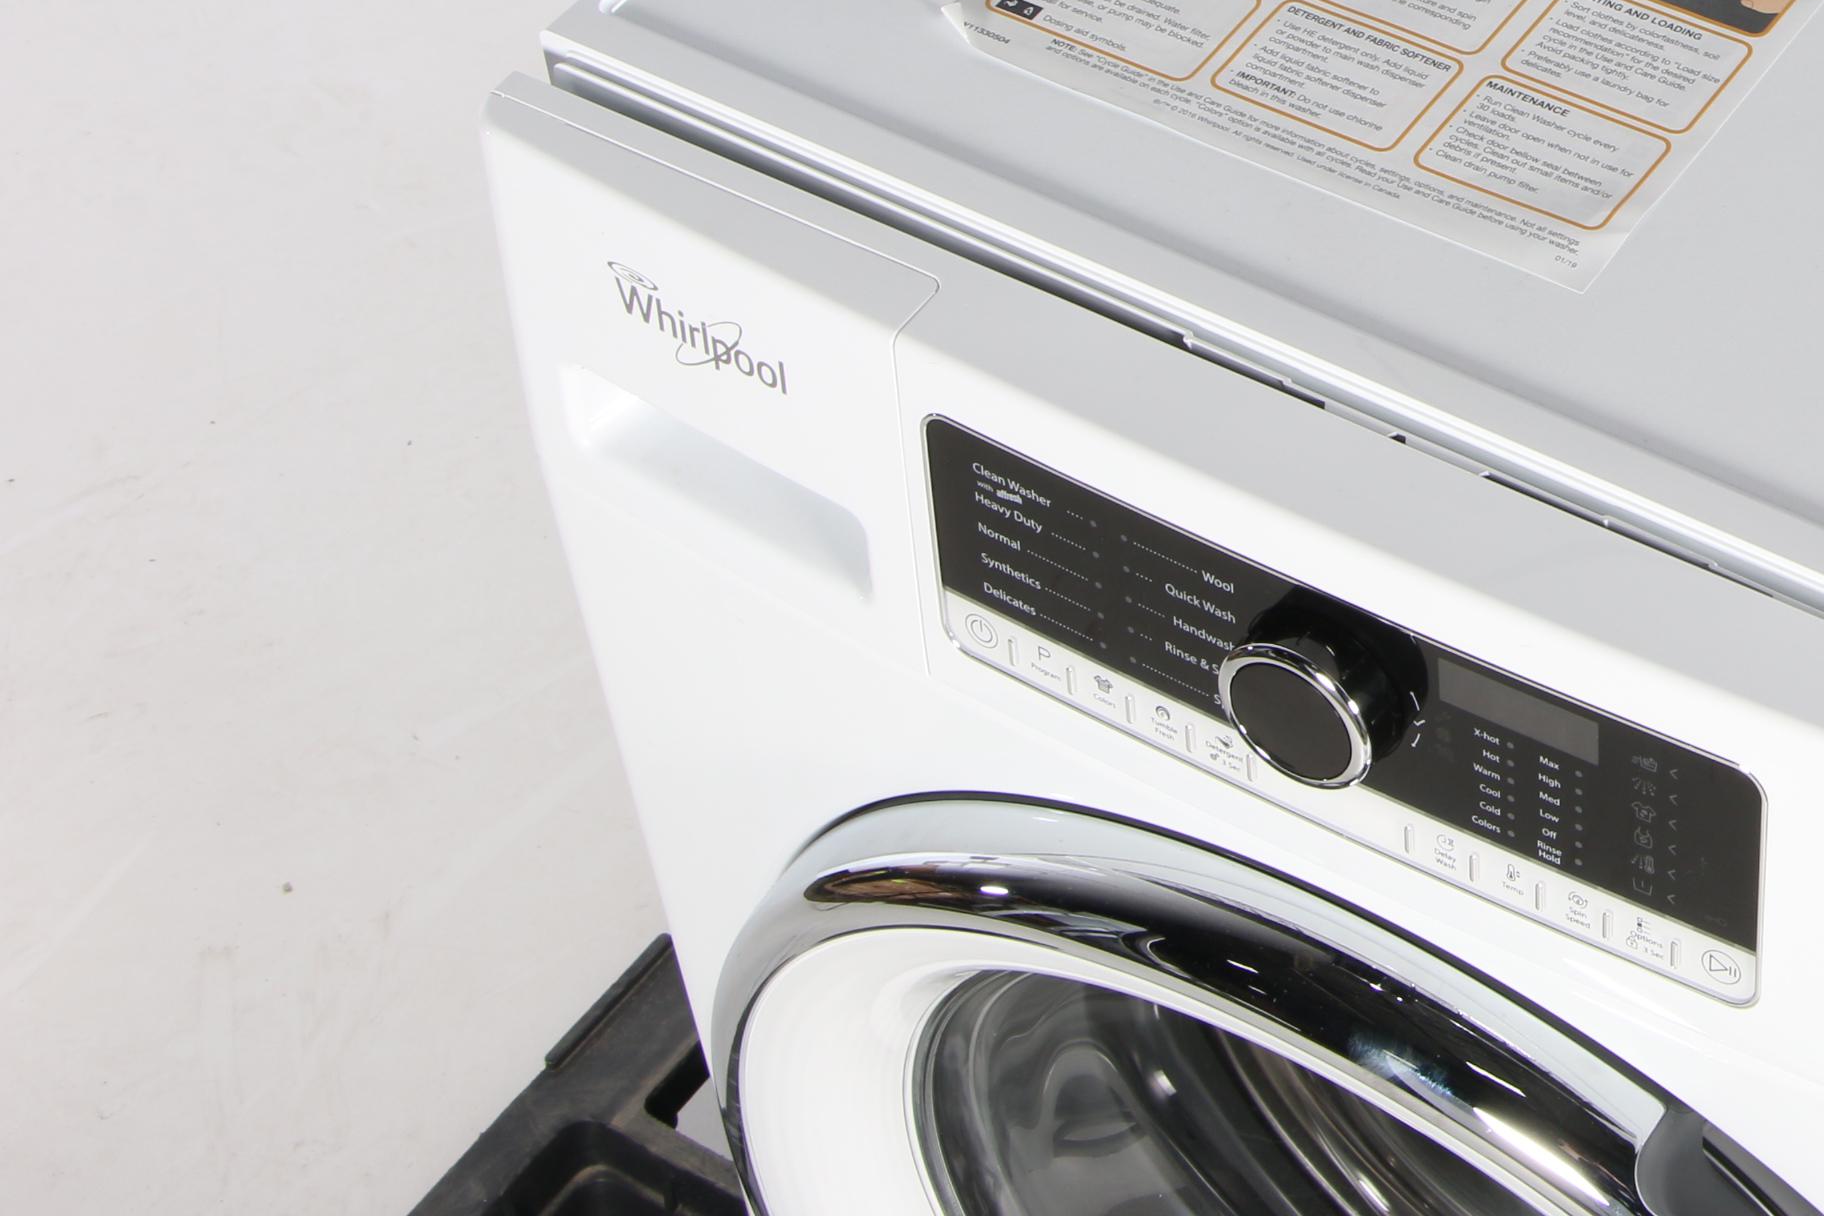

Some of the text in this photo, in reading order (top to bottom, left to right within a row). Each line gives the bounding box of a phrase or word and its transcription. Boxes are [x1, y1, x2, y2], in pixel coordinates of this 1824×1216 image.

[1623, 7, 1650, 20] AND
[1650, 16, 1703, 40] LOADING
[1286, 5, 1452, 72] DETERGENT AND FABRIC SOFTENER
[1235, 70, 1383, 131] IMPORTANT: Do not use chlorine
[1485, 80, 1570, 117] MAINTENANCE
[1553, 254, 1578, 268] 01/19
[612, 272, 788, 395] Whirlpool
[971, 461, 1051, 508] Clean Washer
[974, 490, 1043, 534] Heavy Duty
[977, 521, 1021, 551] Normal
[980, 552, 1041, 590] Synthetics
[1201, 569, 1234, 594] Wool
[983, 581, 1036, 616] Delicates
[1164, 582, 1236, 624] Quick Wash
[1164, 640, 1198, 665] Rinse
[1199, 658, 1210, 671] &
[1473, 727, 1500, 745] X-hot
[1482, 748, 1500, 763] Hot
[1539, 755, 1559, 770] Max
[1472, 762, 1501, 781] Warm
[1537, 772, 1561, 789] High
[1478, 783, 1501, 799] Cool
[1538, 790, 1560, 806] Med
[1478, 800, 1501, 816] Cold
[1539, 808, 1560, 823] Low
[1541, 827, 1557, 840] Off
[1536, 839, 1562, 857] Rinse
[1537, 848, 1561, 865] Hold
